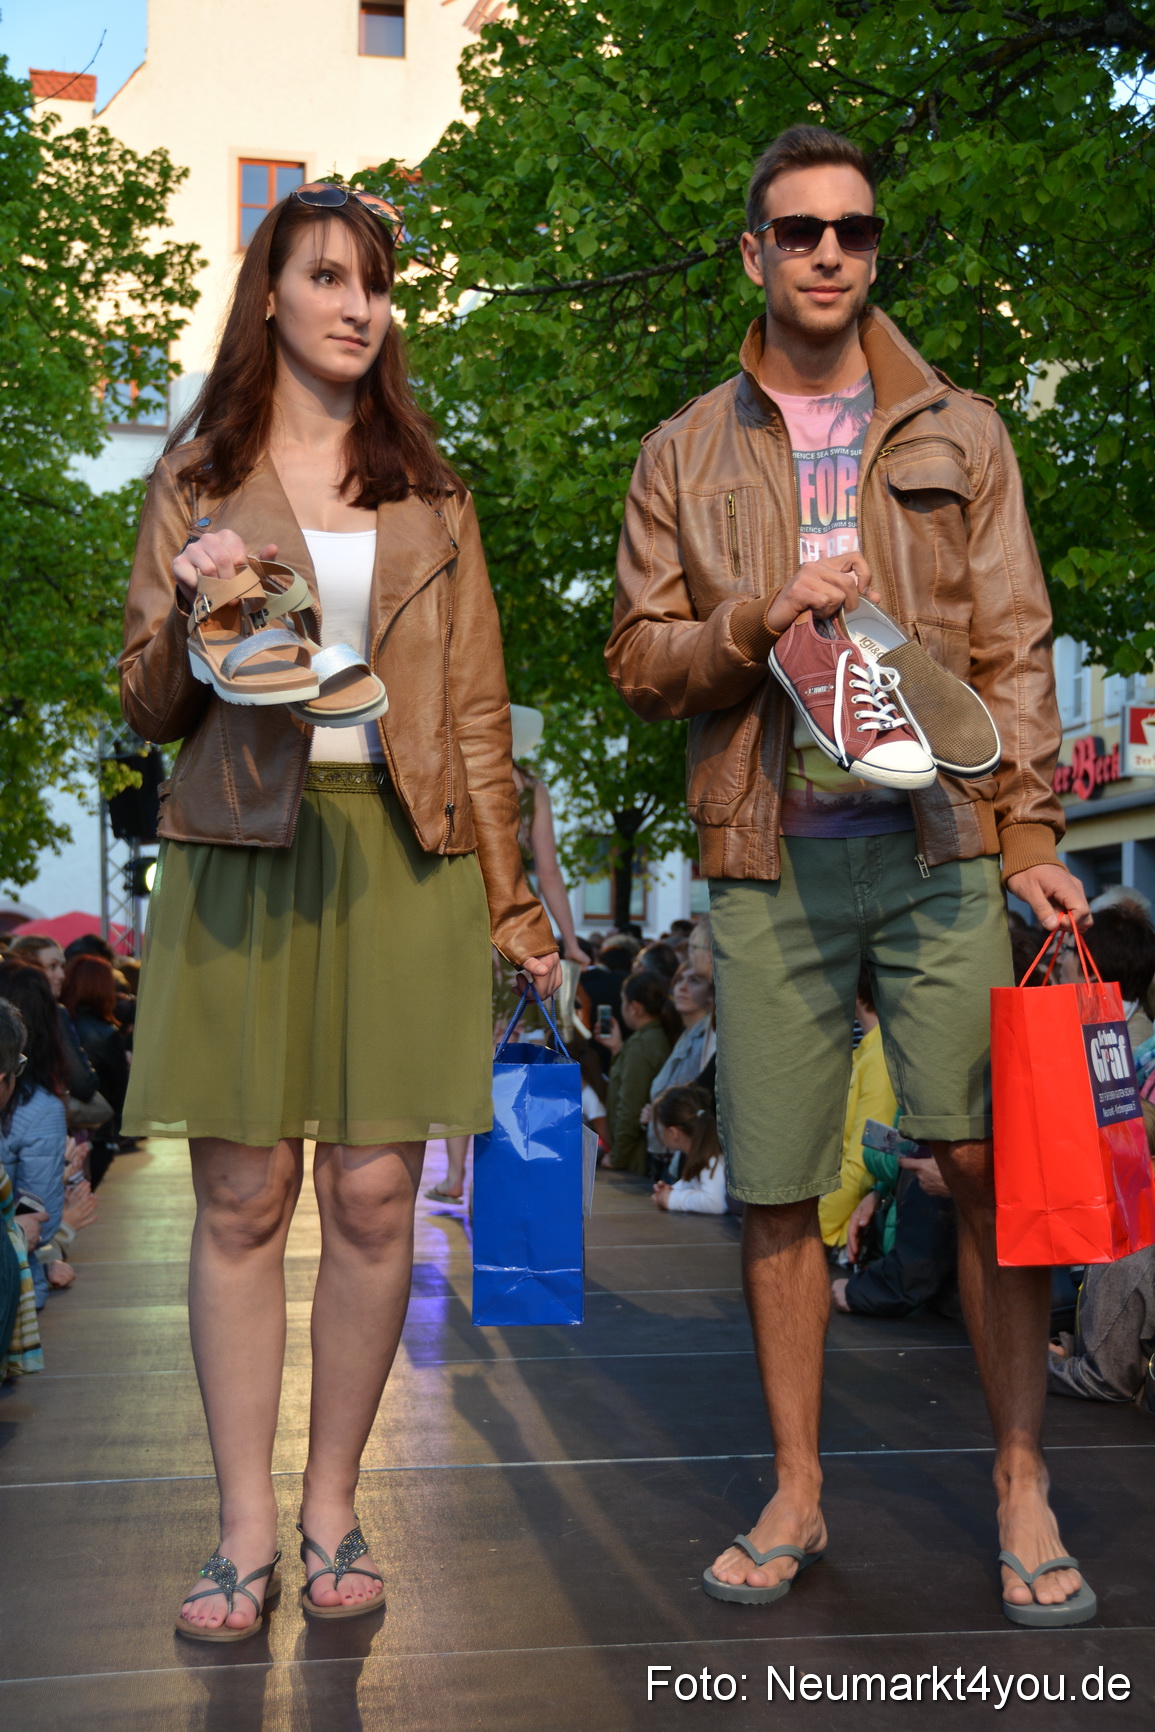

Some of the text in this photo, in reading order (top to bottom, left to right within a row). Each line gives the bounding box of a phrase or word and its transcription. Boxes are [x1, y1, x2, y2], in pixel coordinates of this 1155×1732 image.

[816, 450, 829, 459] SEA
[830, 447, 849, 456] SWIM
[798, 455, 858, 527] FOR
[831, 521, 847, 529] SWIM
[1090, 1034, 1130, 1083] Graf
